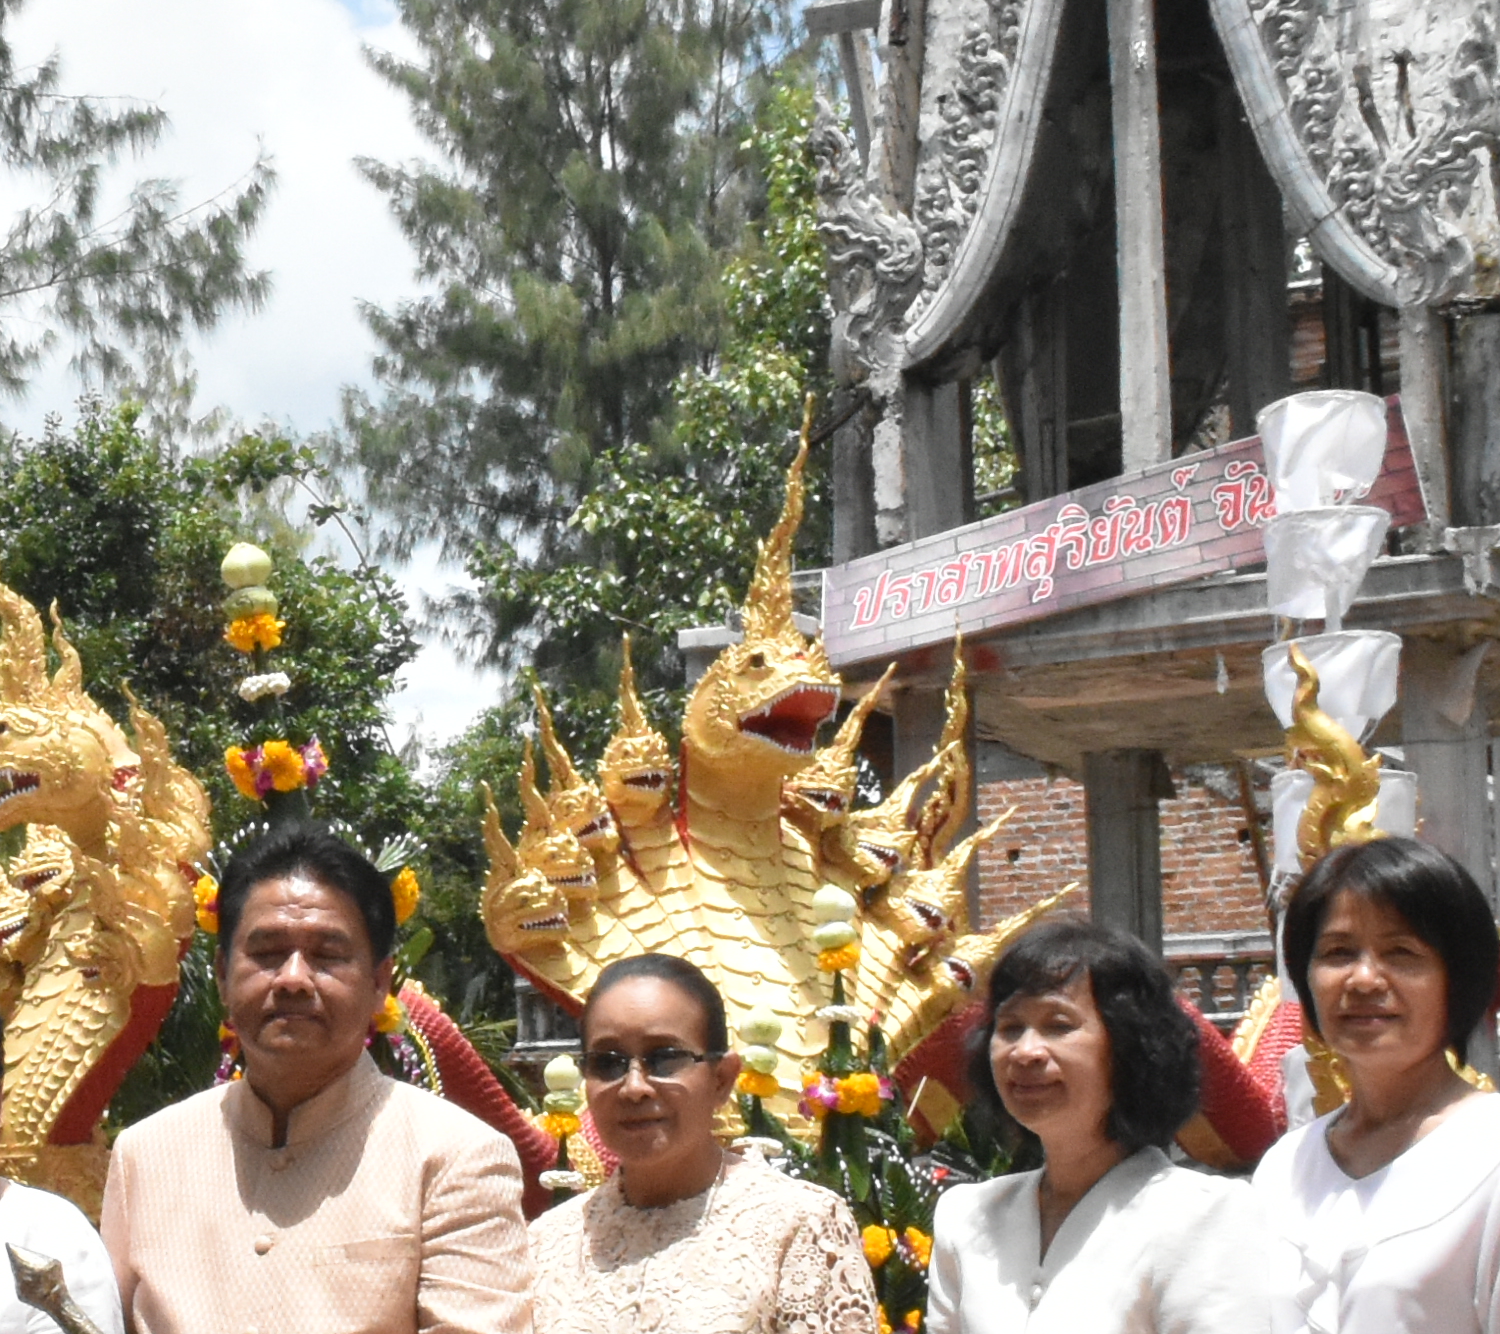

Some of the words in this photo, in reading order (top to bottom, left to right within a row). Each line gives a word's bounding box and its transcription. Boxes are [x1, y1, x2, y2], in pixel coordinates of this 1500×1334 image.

[850, 463, 1200, 630] ปราสาทสุริยันต์
